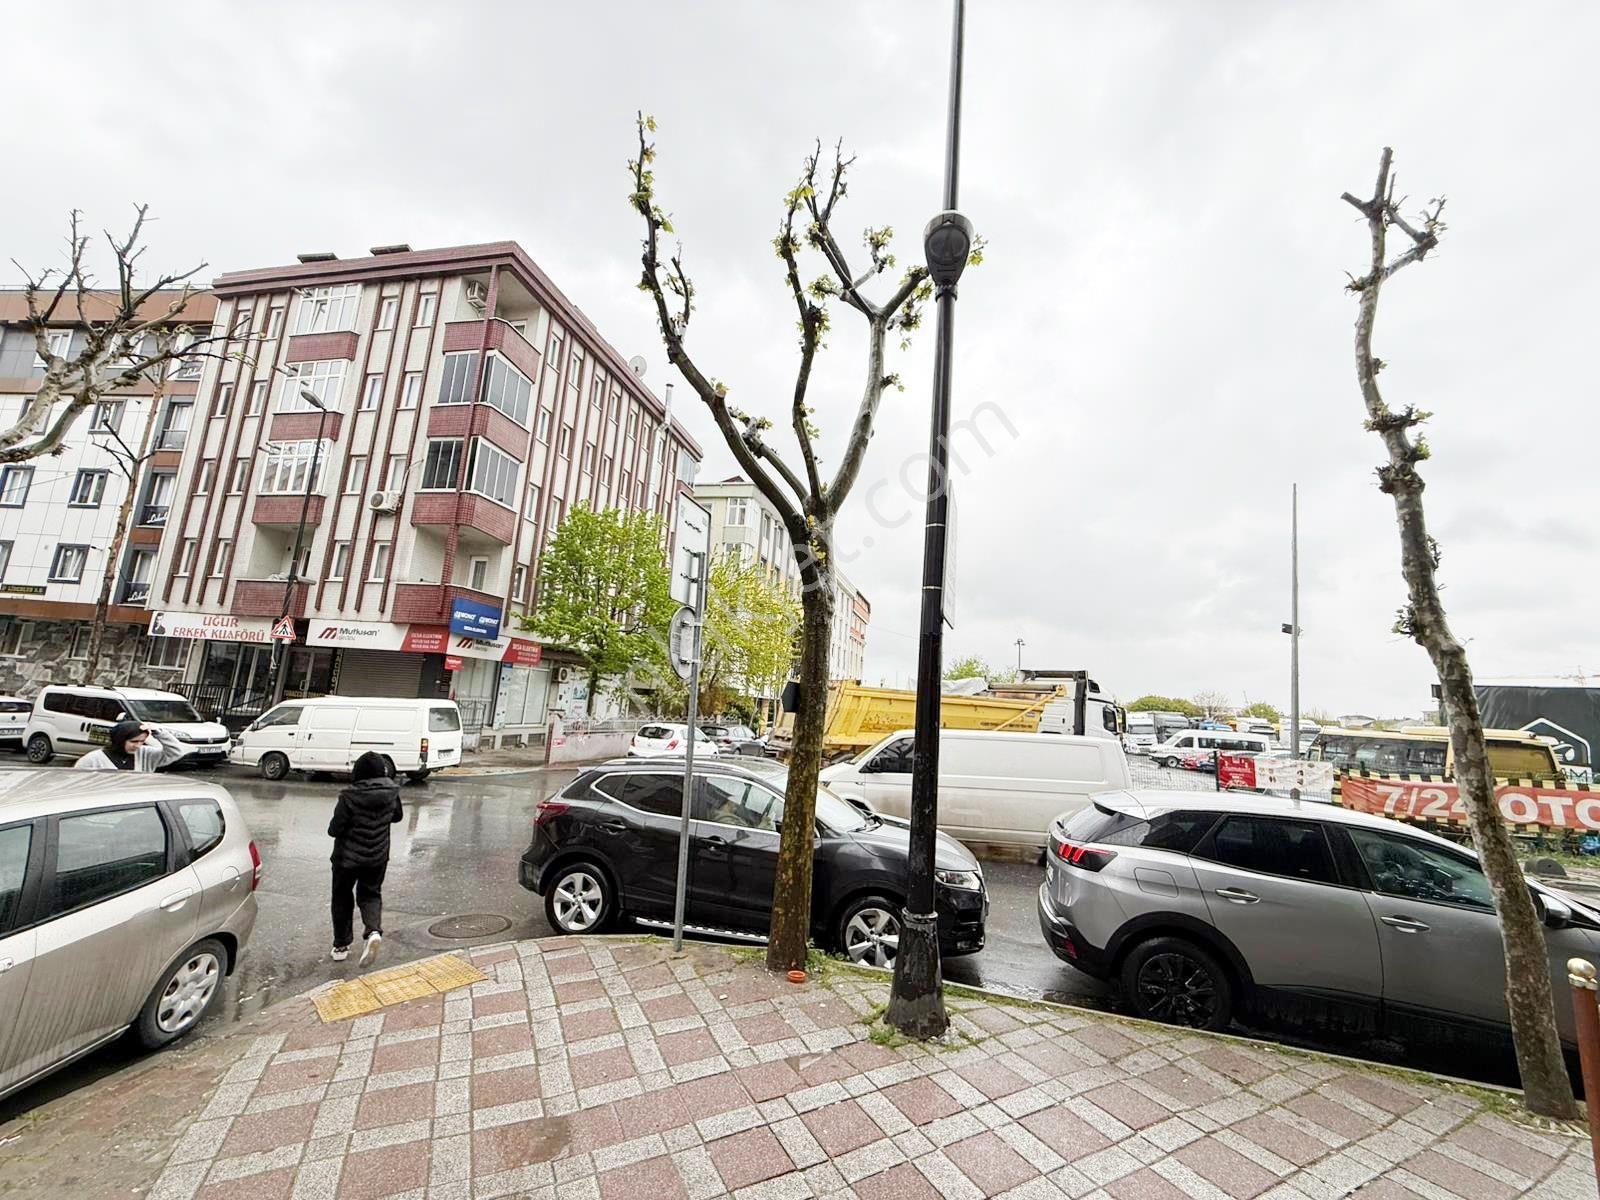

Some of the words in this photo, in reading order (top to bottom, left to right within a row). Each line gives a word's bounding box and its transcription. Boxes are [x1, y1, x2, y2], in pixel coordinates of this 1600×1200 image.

[172, 626, 208, 638] ERKEK
[211, 629, 265, 641] KUAFÖRÜ
[339, 628, 378, 637] Mutlusan
